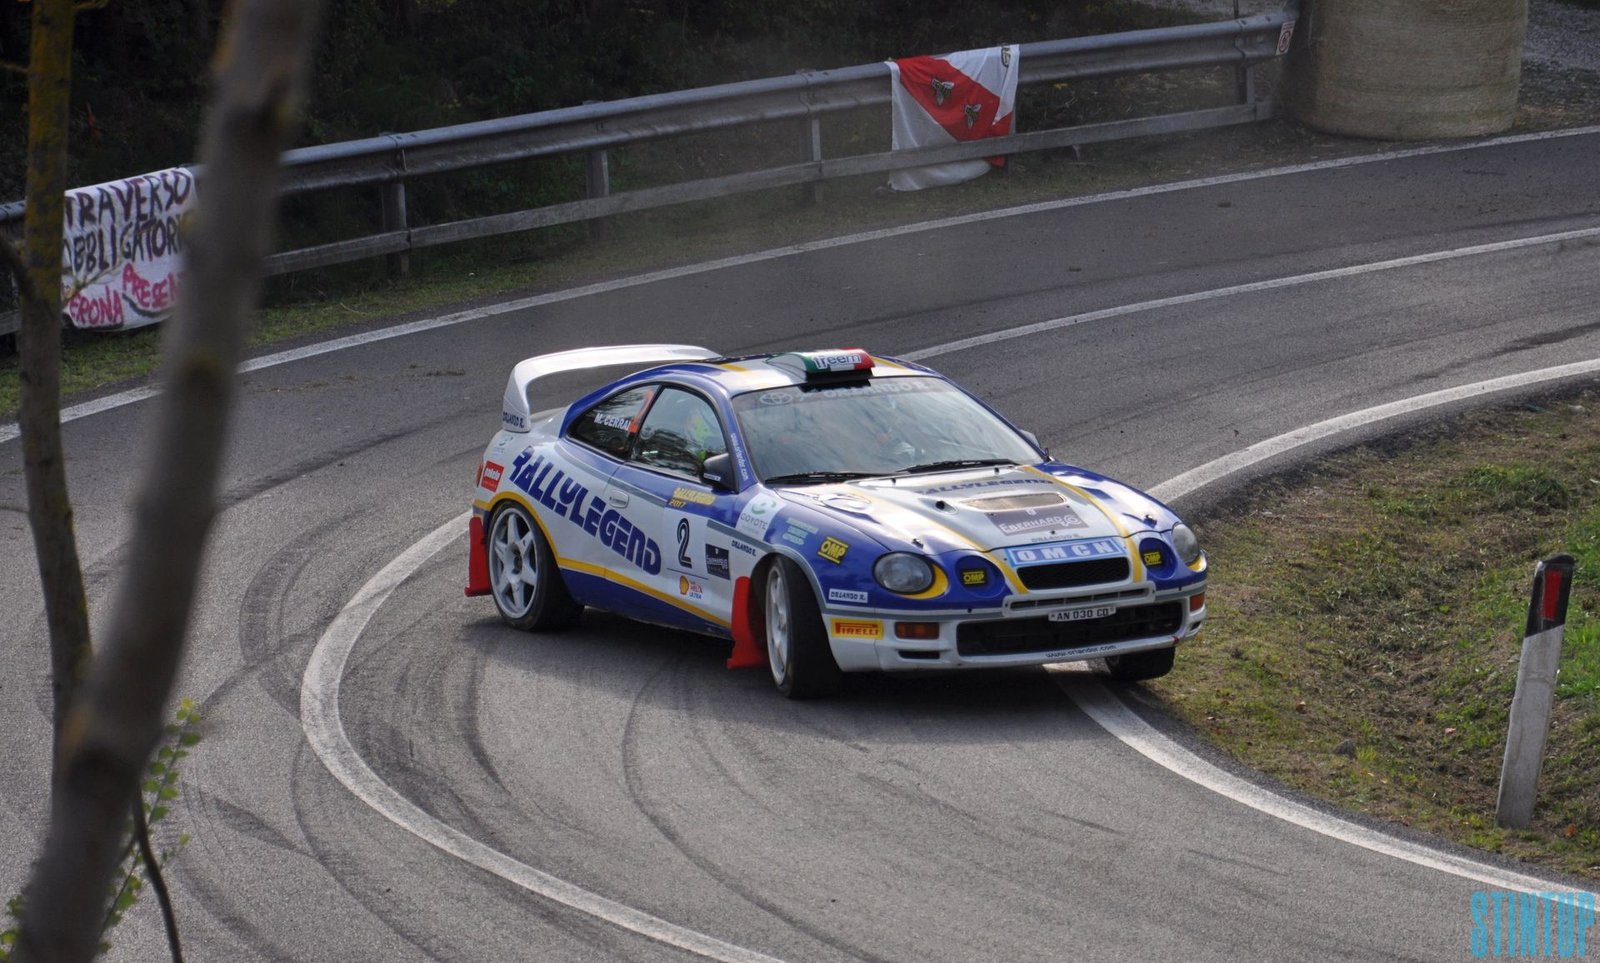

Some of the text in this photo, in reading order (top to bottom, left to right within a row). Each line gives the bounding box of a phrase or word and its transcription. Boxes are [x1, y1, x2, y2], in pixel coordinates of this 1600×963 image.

[65, 170, 191, 230] TRAVERSO
[63, 214, 182, 272] BBLIGATORI
[69, 285, 124, 325] ERONA
[509, 446, 661, 575] RALLYLEGEND
[740, 513, 768, 530] COYOTE
[677, 517, 693, 569] 2
[820, 540, 846, 559] OMP
[1018, 541, 1115, 562] OMCN
[1144, 553, 1160, 564] OMP
[963, 572, 985, 582] OMP
[830, 591, 858, 600] ORLANDO
[1056, 611, 1070, 621] AN
[1073, 609, 1093, 619] 030
[835, 622, 879, 636] PIRELLI
